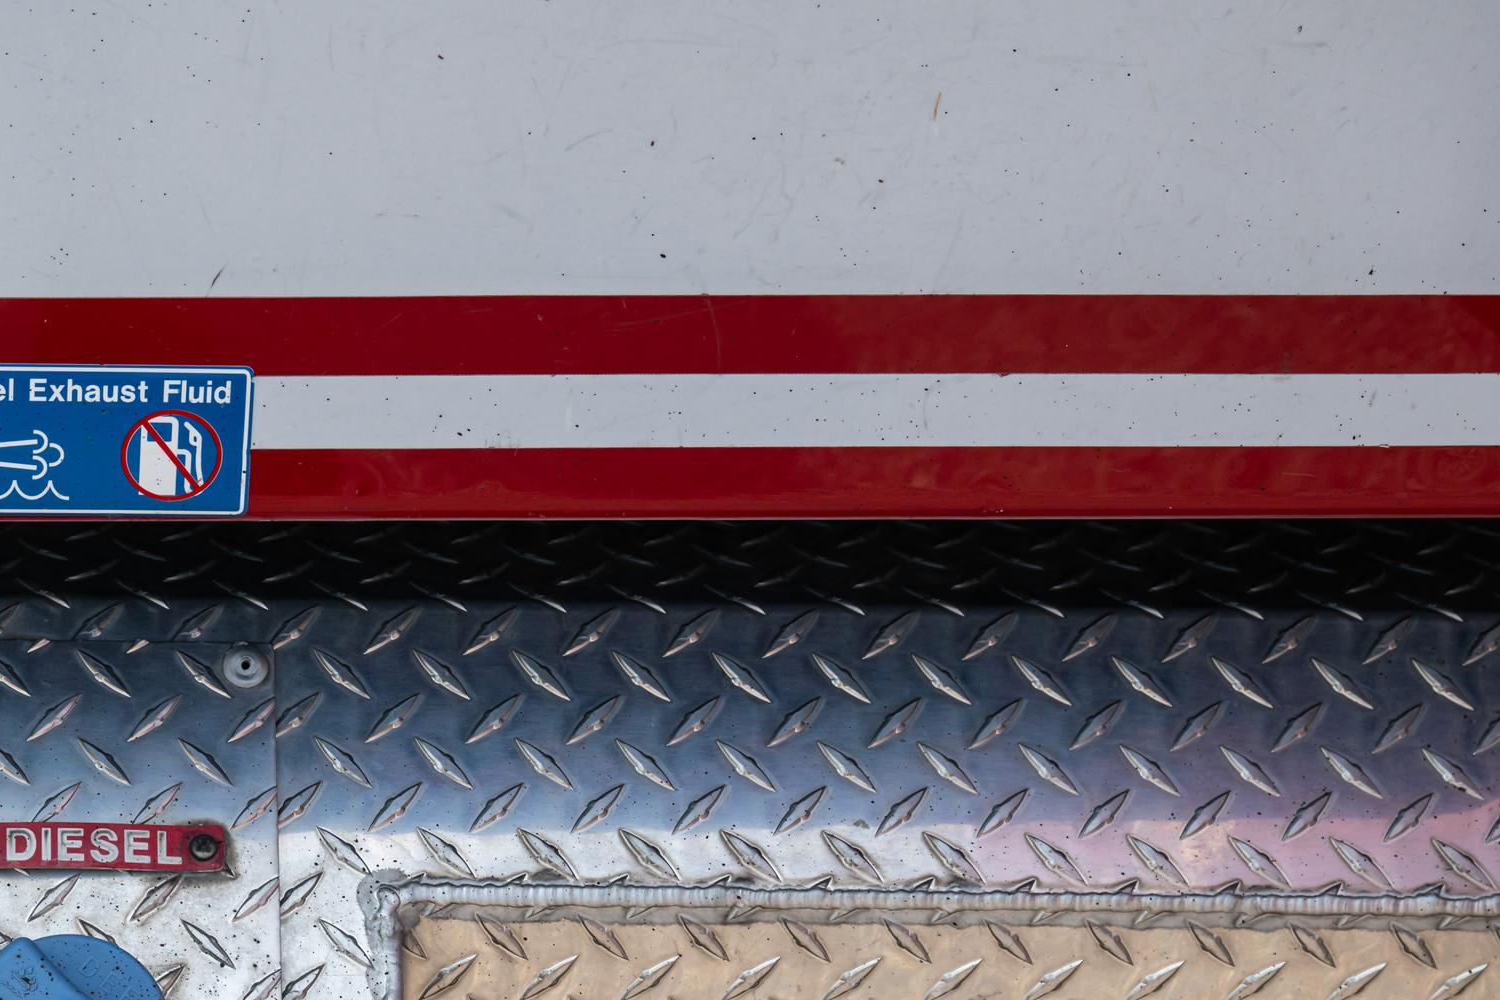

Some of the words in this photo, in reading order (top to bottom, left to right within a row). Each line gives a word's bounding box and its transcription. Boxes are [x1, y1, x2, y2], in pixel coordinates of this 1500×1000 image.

[28, 377, 148, 403] Exhaust
[162, 379, 232, 404] Fluid
[5, 826, 182, 865] DIESEL
